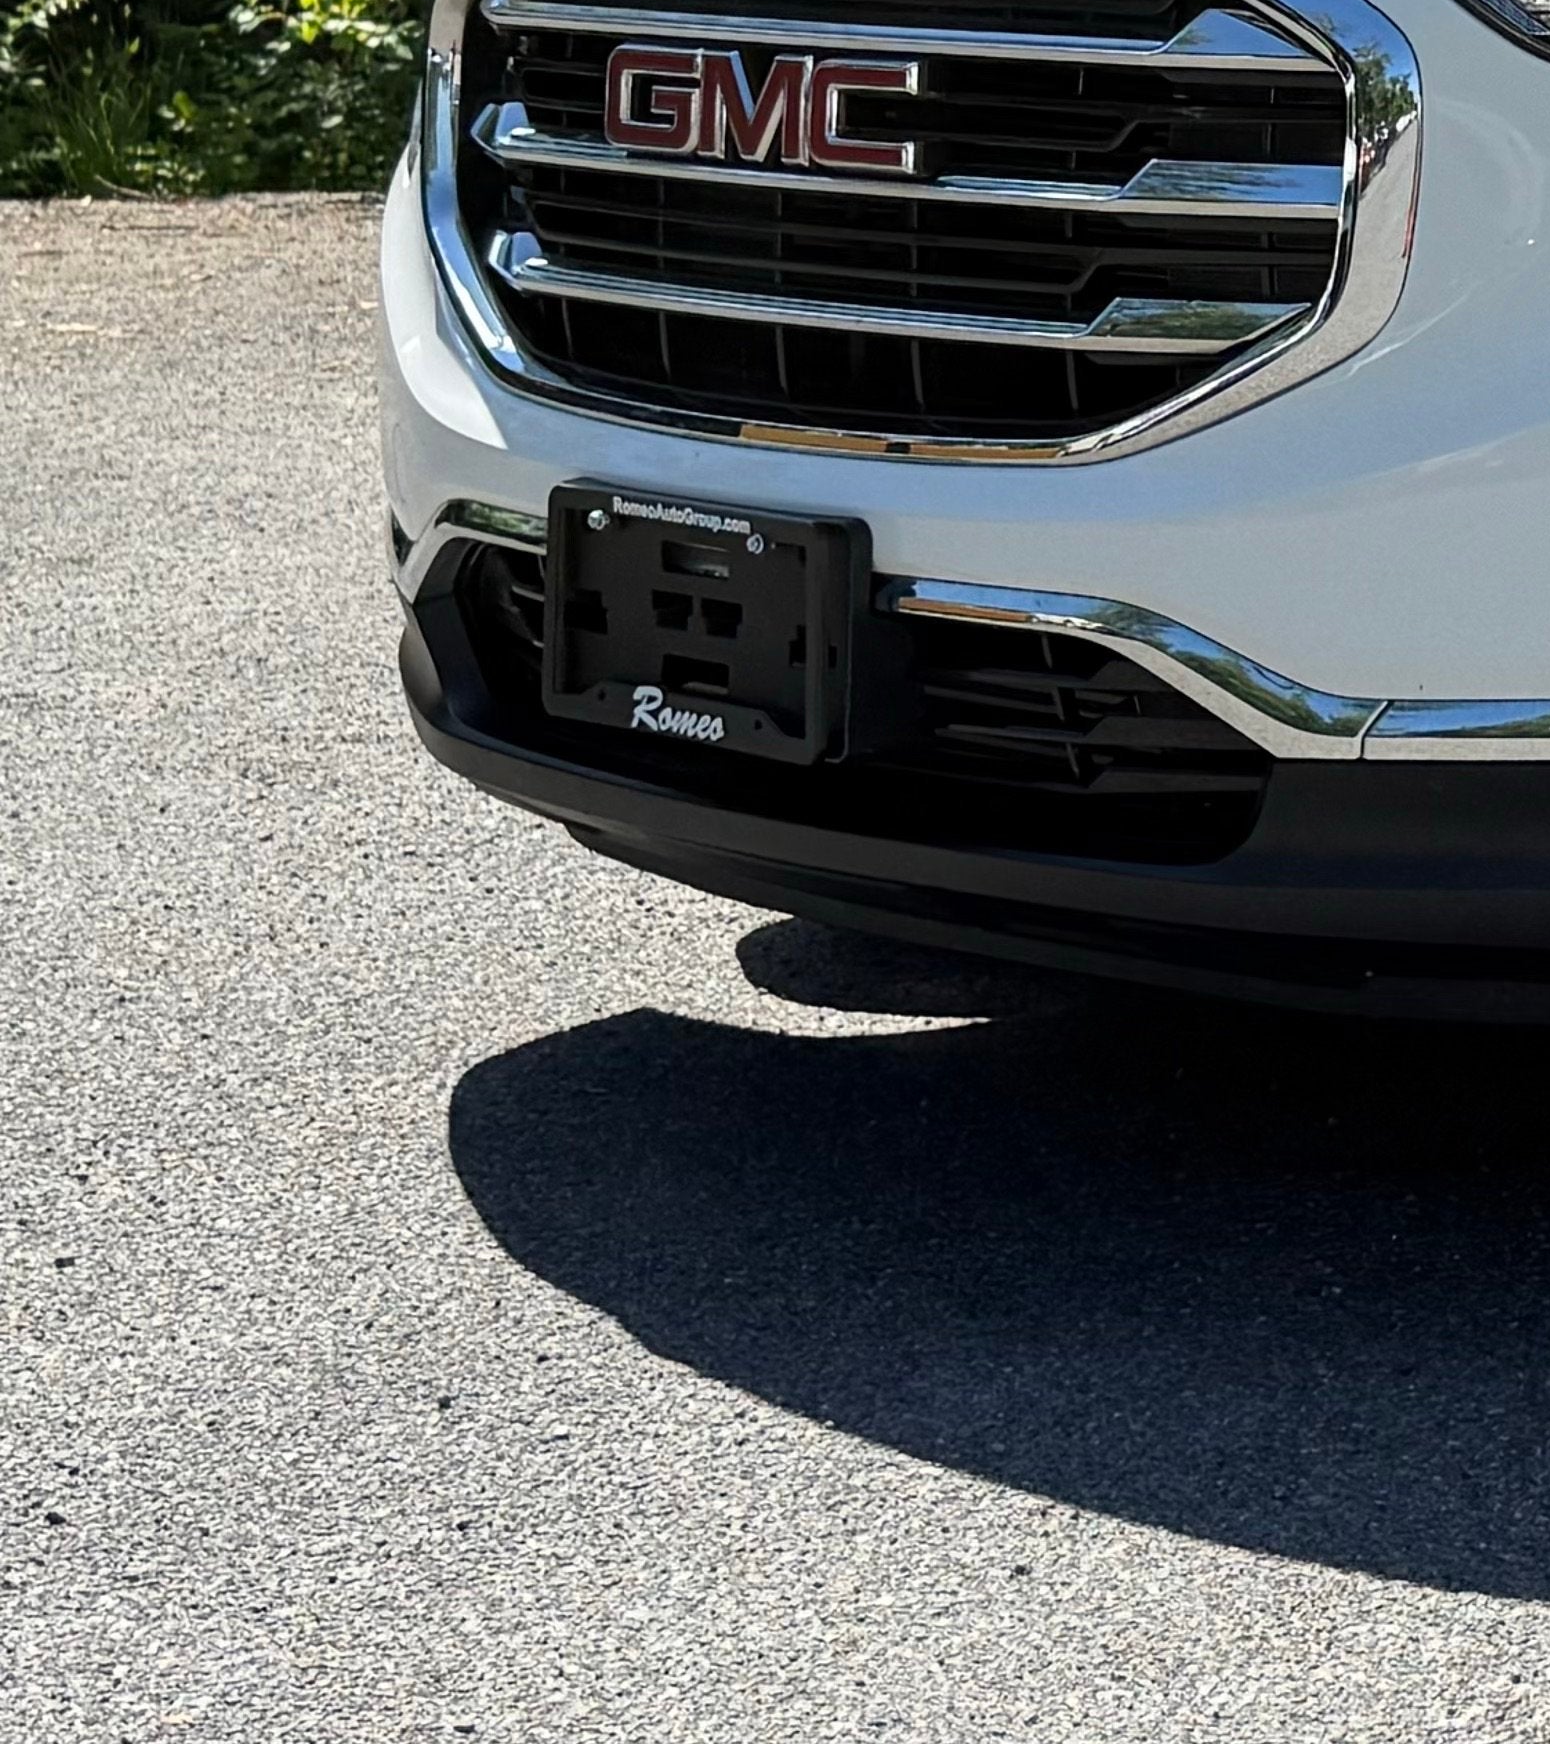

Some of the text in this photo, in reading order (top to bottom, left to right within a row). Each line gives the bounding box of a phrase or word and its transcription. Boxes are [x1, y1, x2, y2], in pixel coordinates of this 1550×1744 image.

[605, 43, 919, 174] GMC
[612, 495, 752, 535] RomeoAutoGroup.com
[630, 685, 725, 742] Romeo
